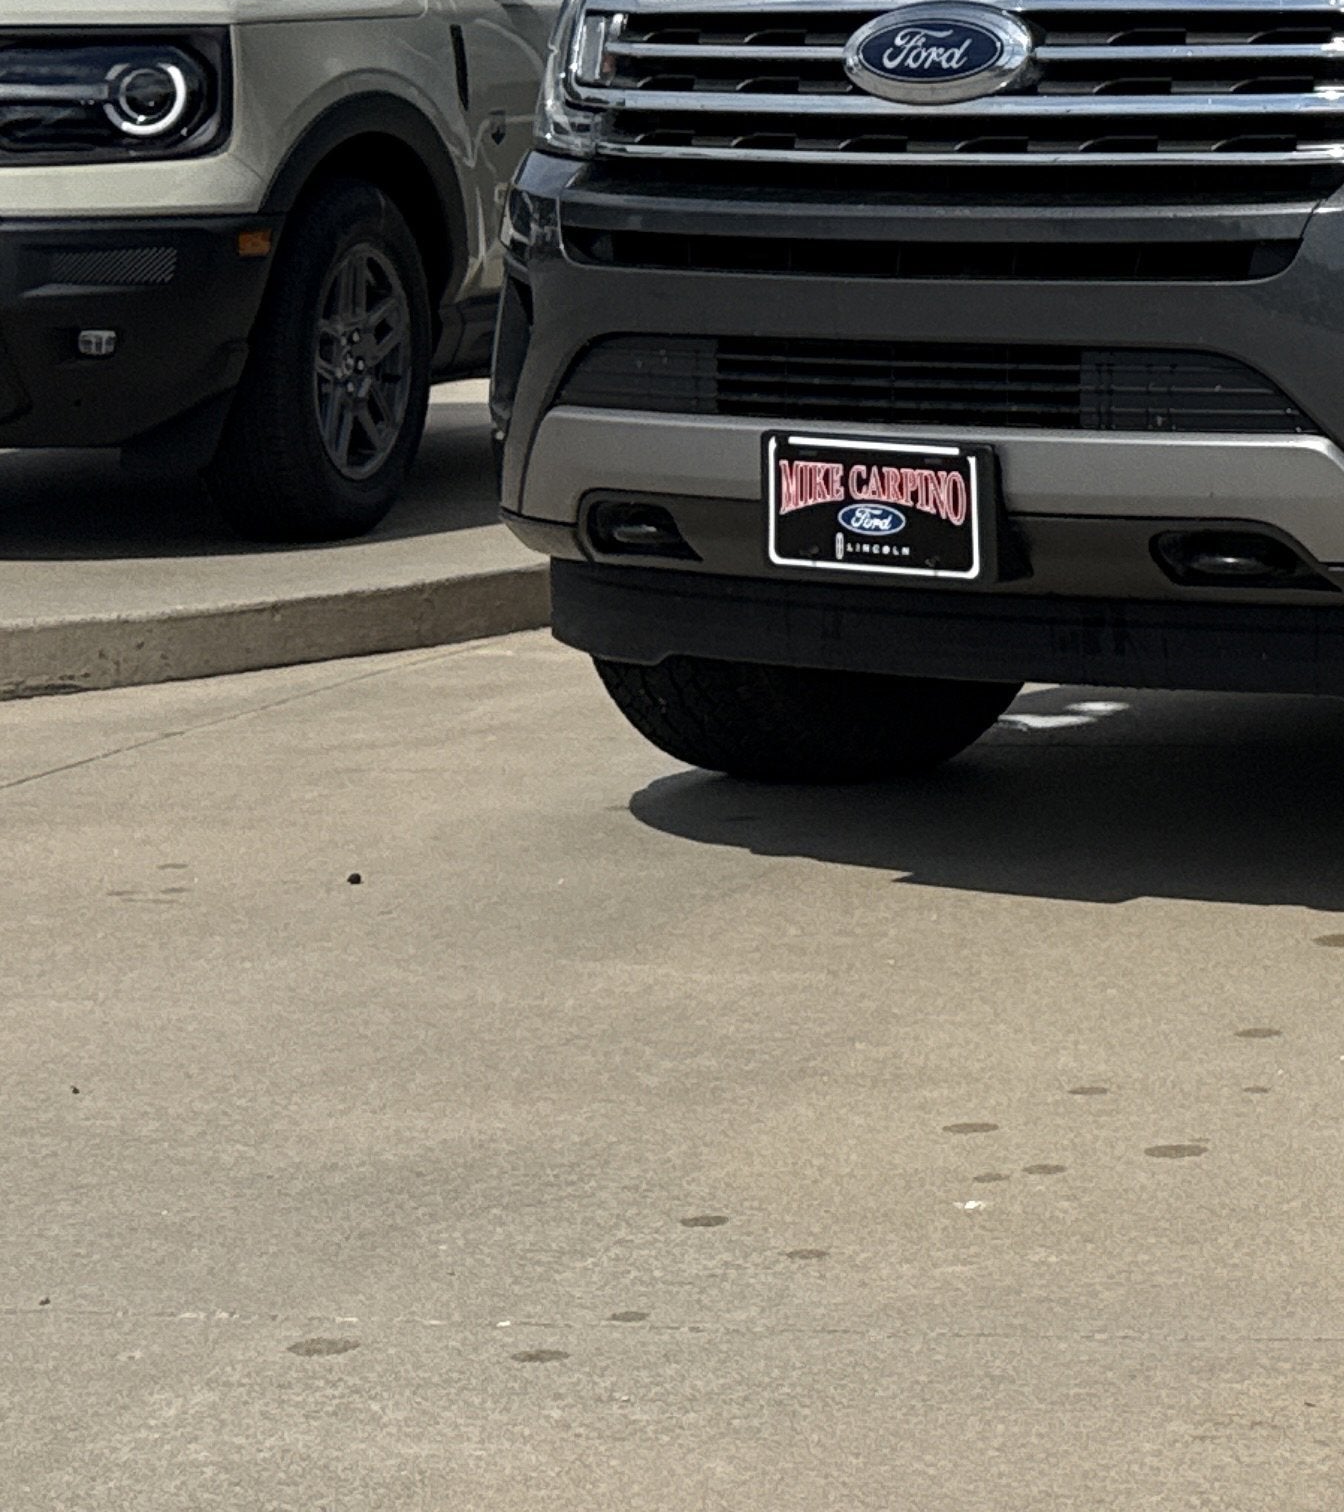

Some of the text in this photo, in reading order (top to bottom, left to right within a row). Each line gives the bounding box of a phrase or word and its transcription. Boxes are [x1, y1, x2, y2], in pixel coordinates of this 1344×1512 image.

[882, 27, 972, 69] Ford
[779, 459, 967, 526] MIKE CARPINO
[850, 506, 892, 531] Ford
[846, 542, 910, 556] LINCOLN
